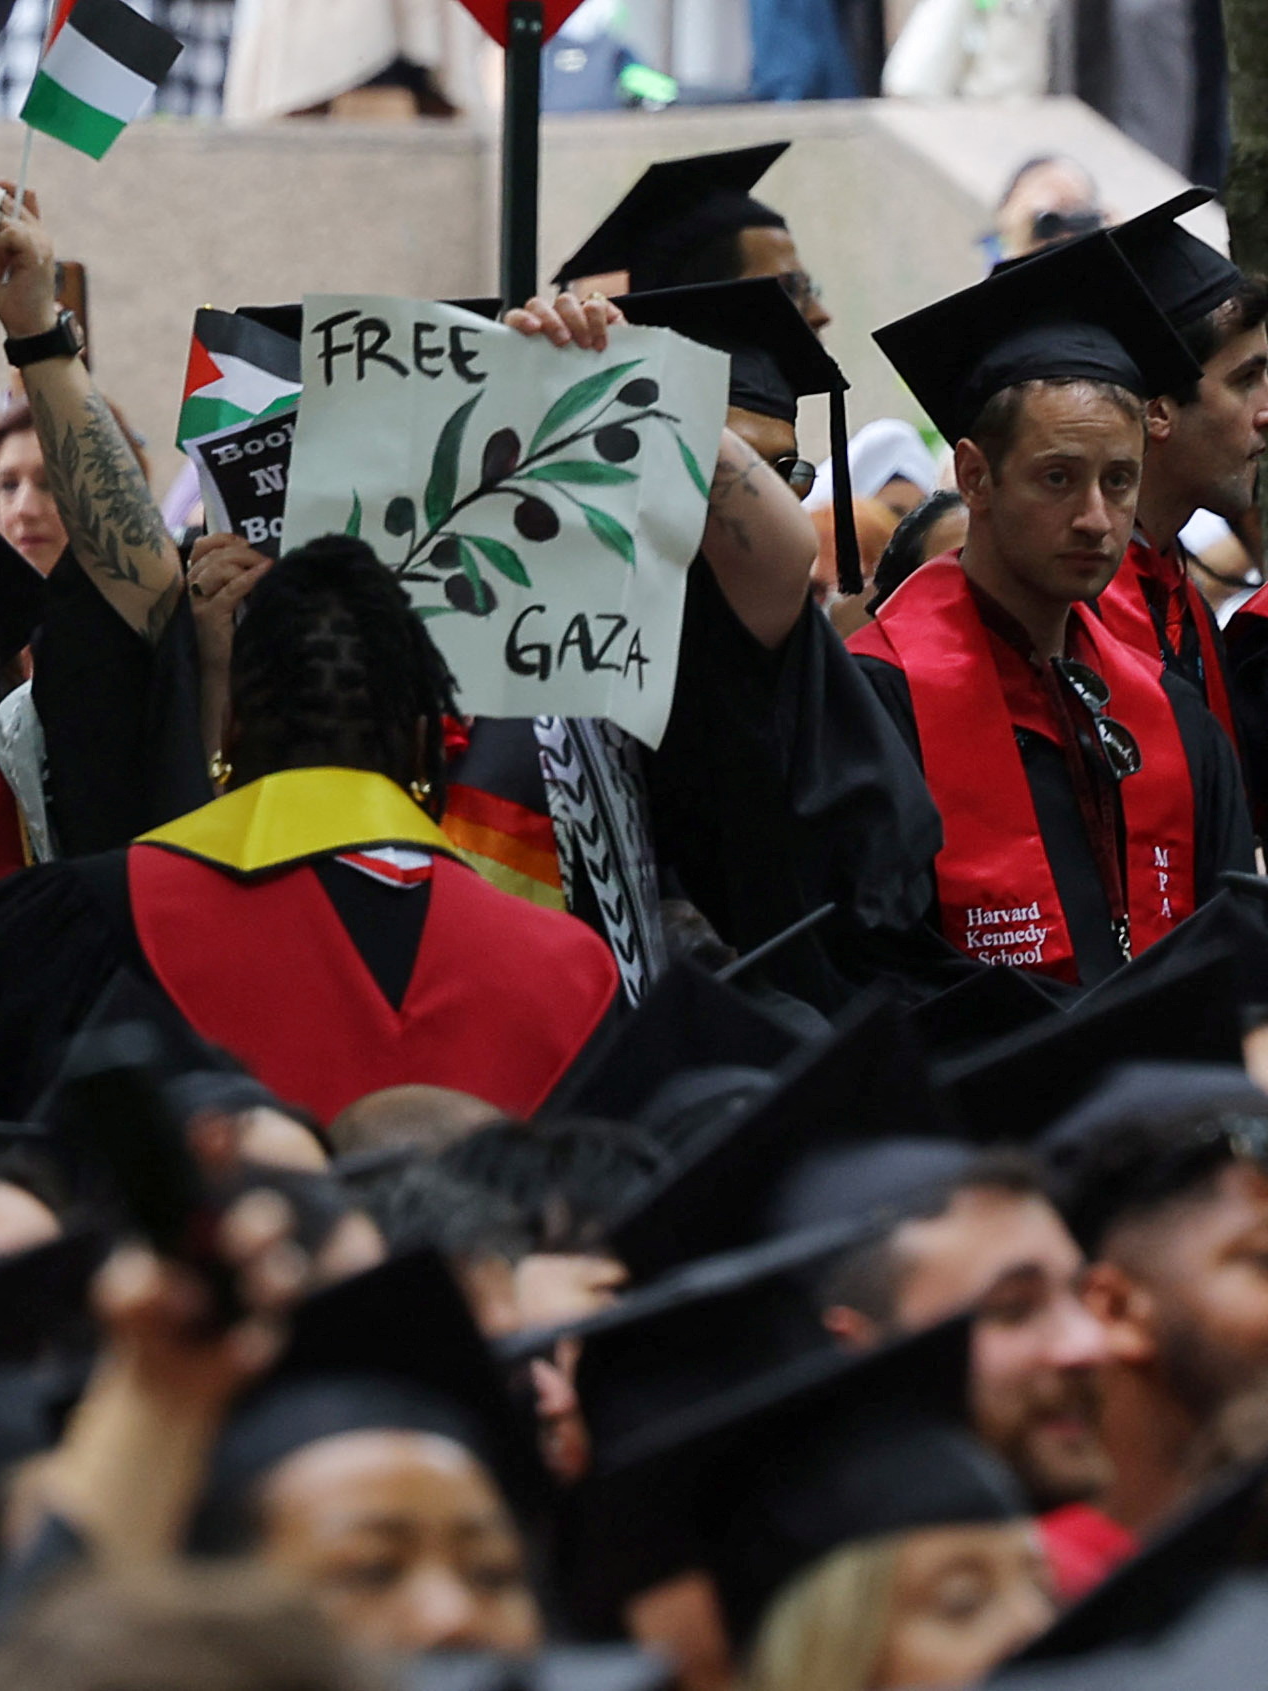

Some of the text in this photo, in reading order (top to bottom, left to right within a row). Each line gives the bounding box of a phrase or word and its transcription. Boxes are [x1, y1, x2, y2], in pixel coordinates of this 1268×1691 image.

[312, 309, 489, 386] FREE
[504, 605, 651, 690] GAZA
[966, 901, 1041, 927] Harvard
[965, 924, 1048, 949] Kennedy
[977, 944, 1044, 967] School
